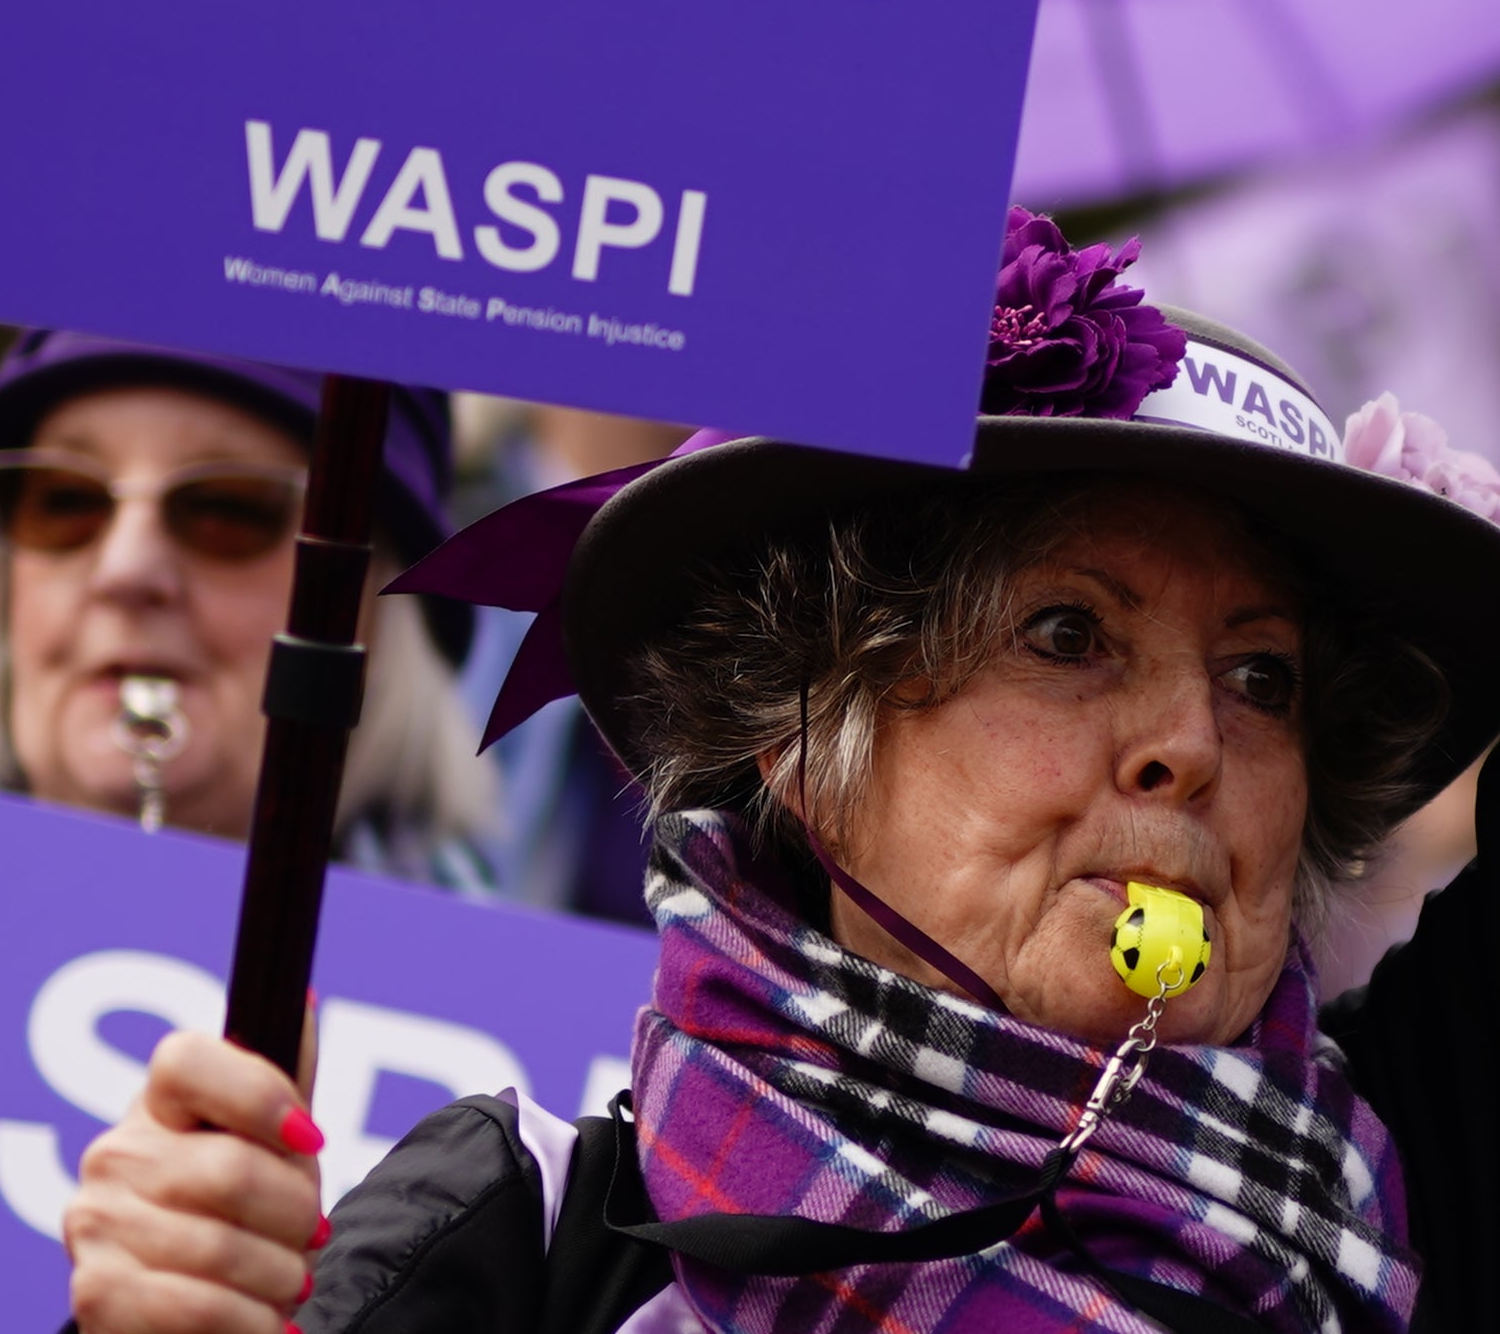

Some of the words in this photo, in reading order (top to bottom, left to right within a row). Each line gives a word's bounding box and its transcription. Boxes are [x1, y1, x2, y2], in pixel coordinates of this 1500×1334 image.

[245, 119, 707, 297] WASPI
[224, 256, 317, 292] Women
[321, 271, 413, 306] Against
[417, 286, 480, 318] State
[486, 298, 582, 334] Pension
[587, 313, 686, 351] Injustice
